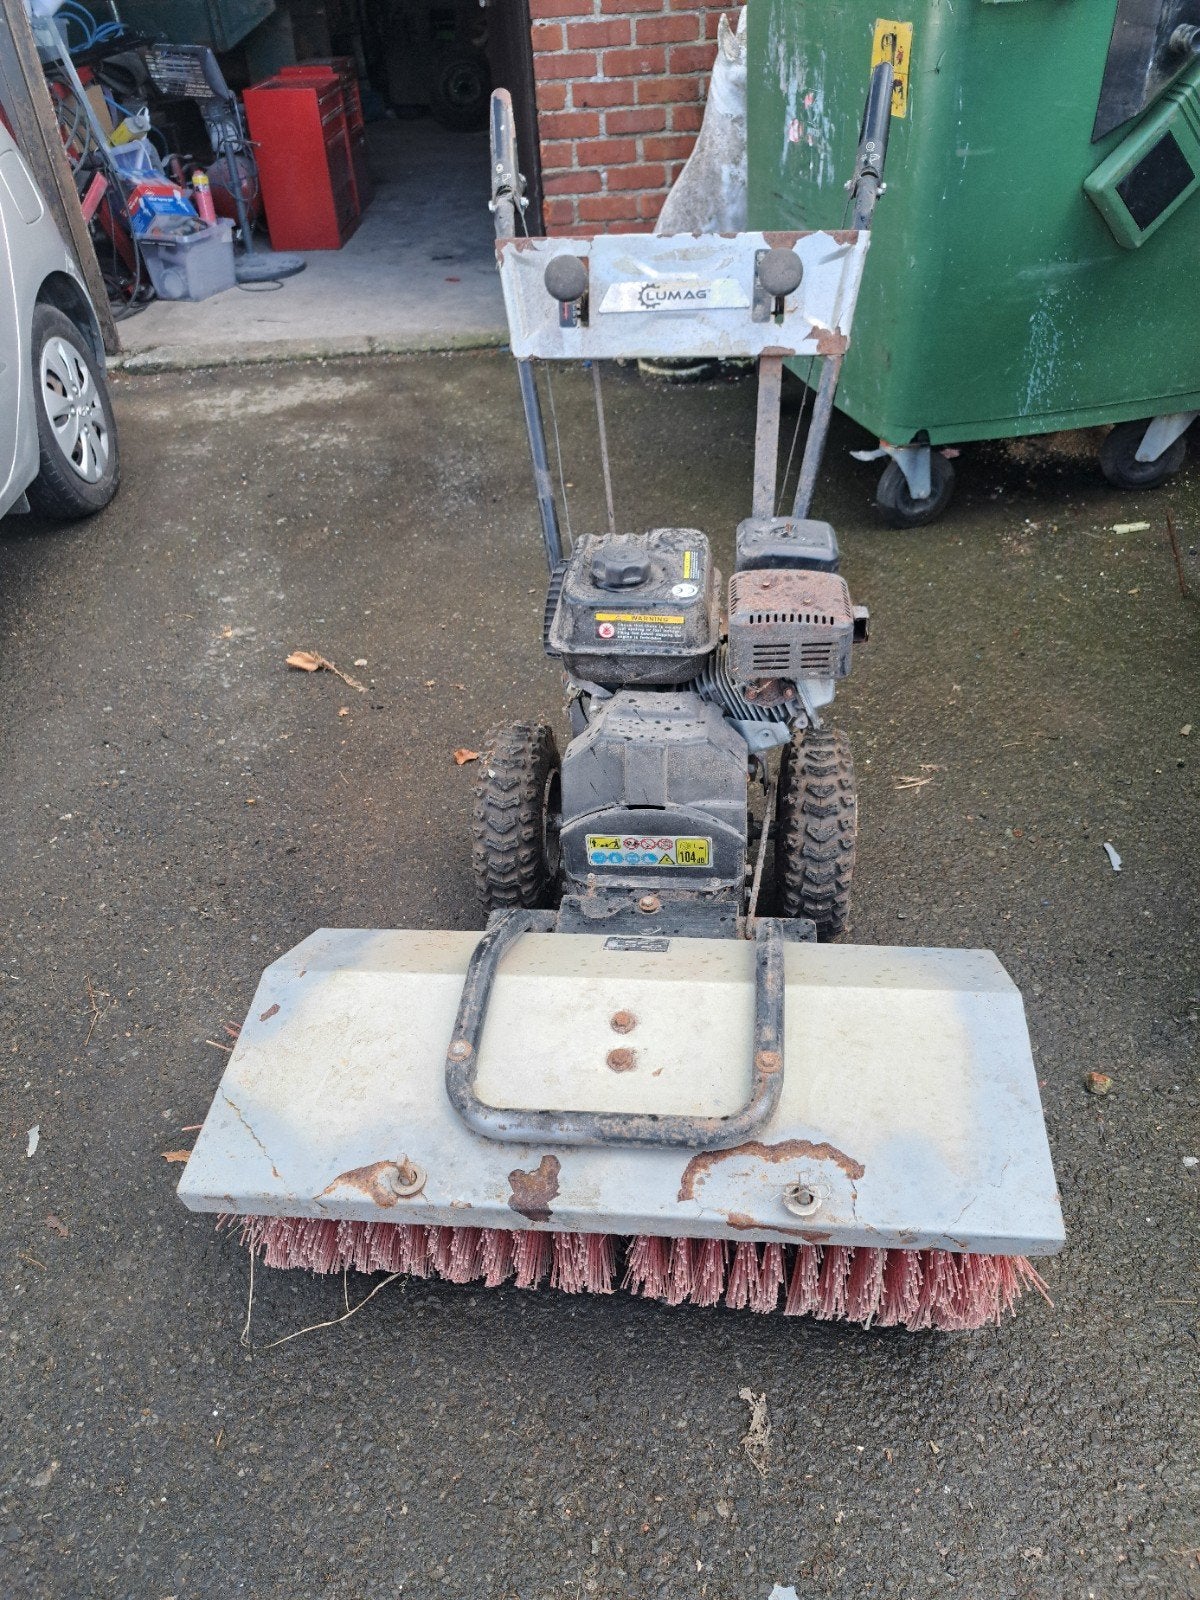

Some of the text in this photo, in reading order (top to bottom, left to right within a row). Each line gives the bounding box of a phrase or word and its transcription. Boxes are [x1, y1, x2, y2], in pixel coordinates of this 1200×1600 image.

[646, 289, 707, 301] LUMAG
[631, 614, 669, 622] WARNING
[680, 851, 696, 863] 104
